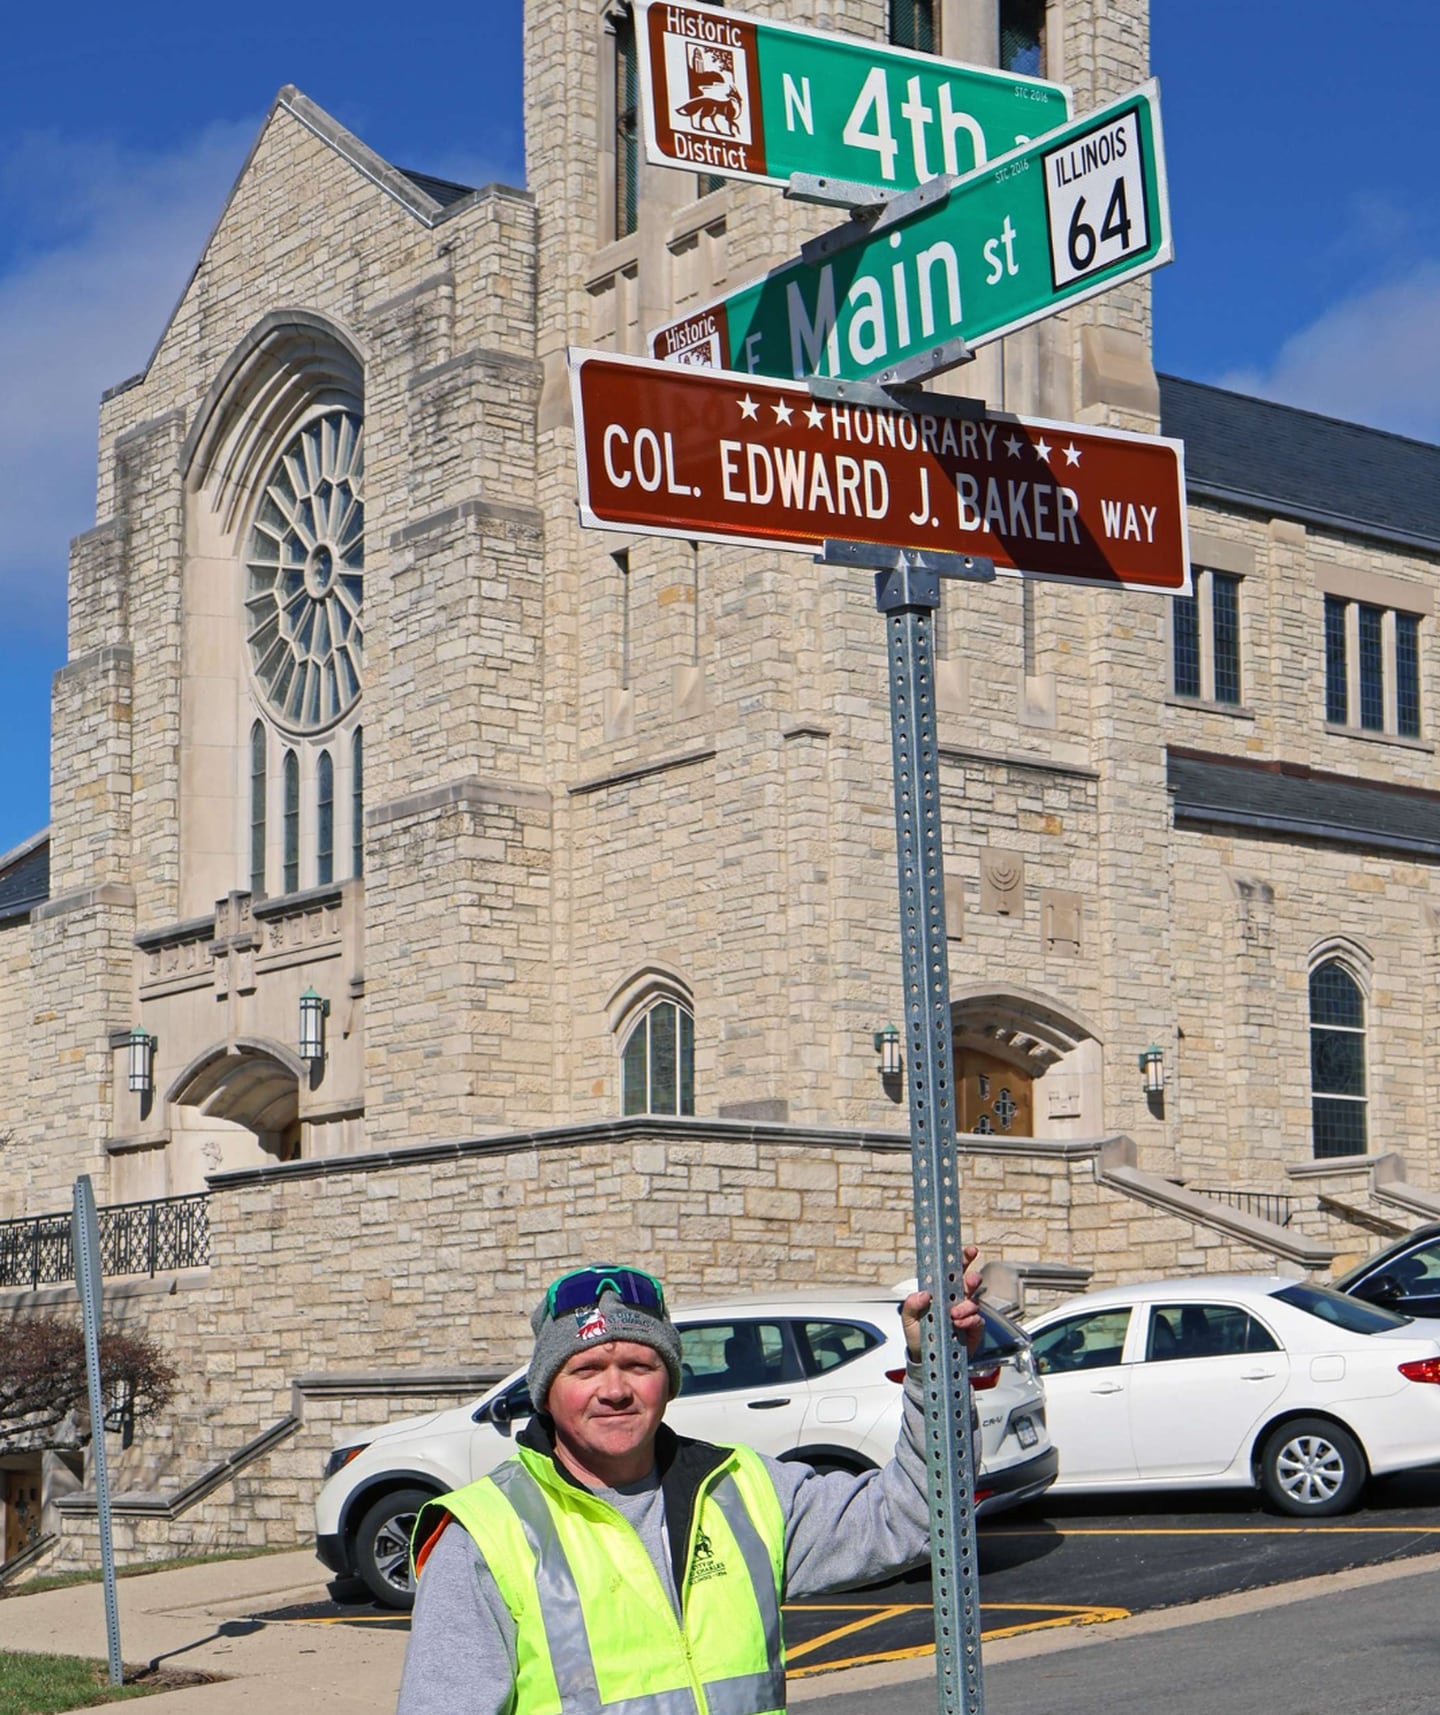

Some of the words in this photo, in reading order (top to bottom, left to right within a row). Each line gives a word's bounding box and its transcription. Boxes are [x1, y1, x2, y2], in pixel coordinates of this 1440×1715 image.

[666, 6, 742, 47] Historic
[1015, 86, 1029, 99] STC
[1031, 90, 1048, 103] 2016
[673, 133, 747, 171] District
[783, 73, 814, 135] N
[843, 67, 987, 185] 4th
[995, 168, 1009, 184] STC
[1010, 159, 1029, 176] 2016
[1056, 127, 1127, 188] ILLINOIS
[1068, 176, 1131, 271] 64
[786, 231, 962, 380] Main
[983, 215, 1019, 285] st
[665, 313, 717, 354] Historic
[831, 402, 998, 461] HONORARY
[603, 424, 701, 498] COL.
[719, 439, 890, 520] EDWARD
[909, 467, 940, 528] J.
[955, 472, 1080, 545] BAKER
[1100, 499, 1157, 544] WAY
